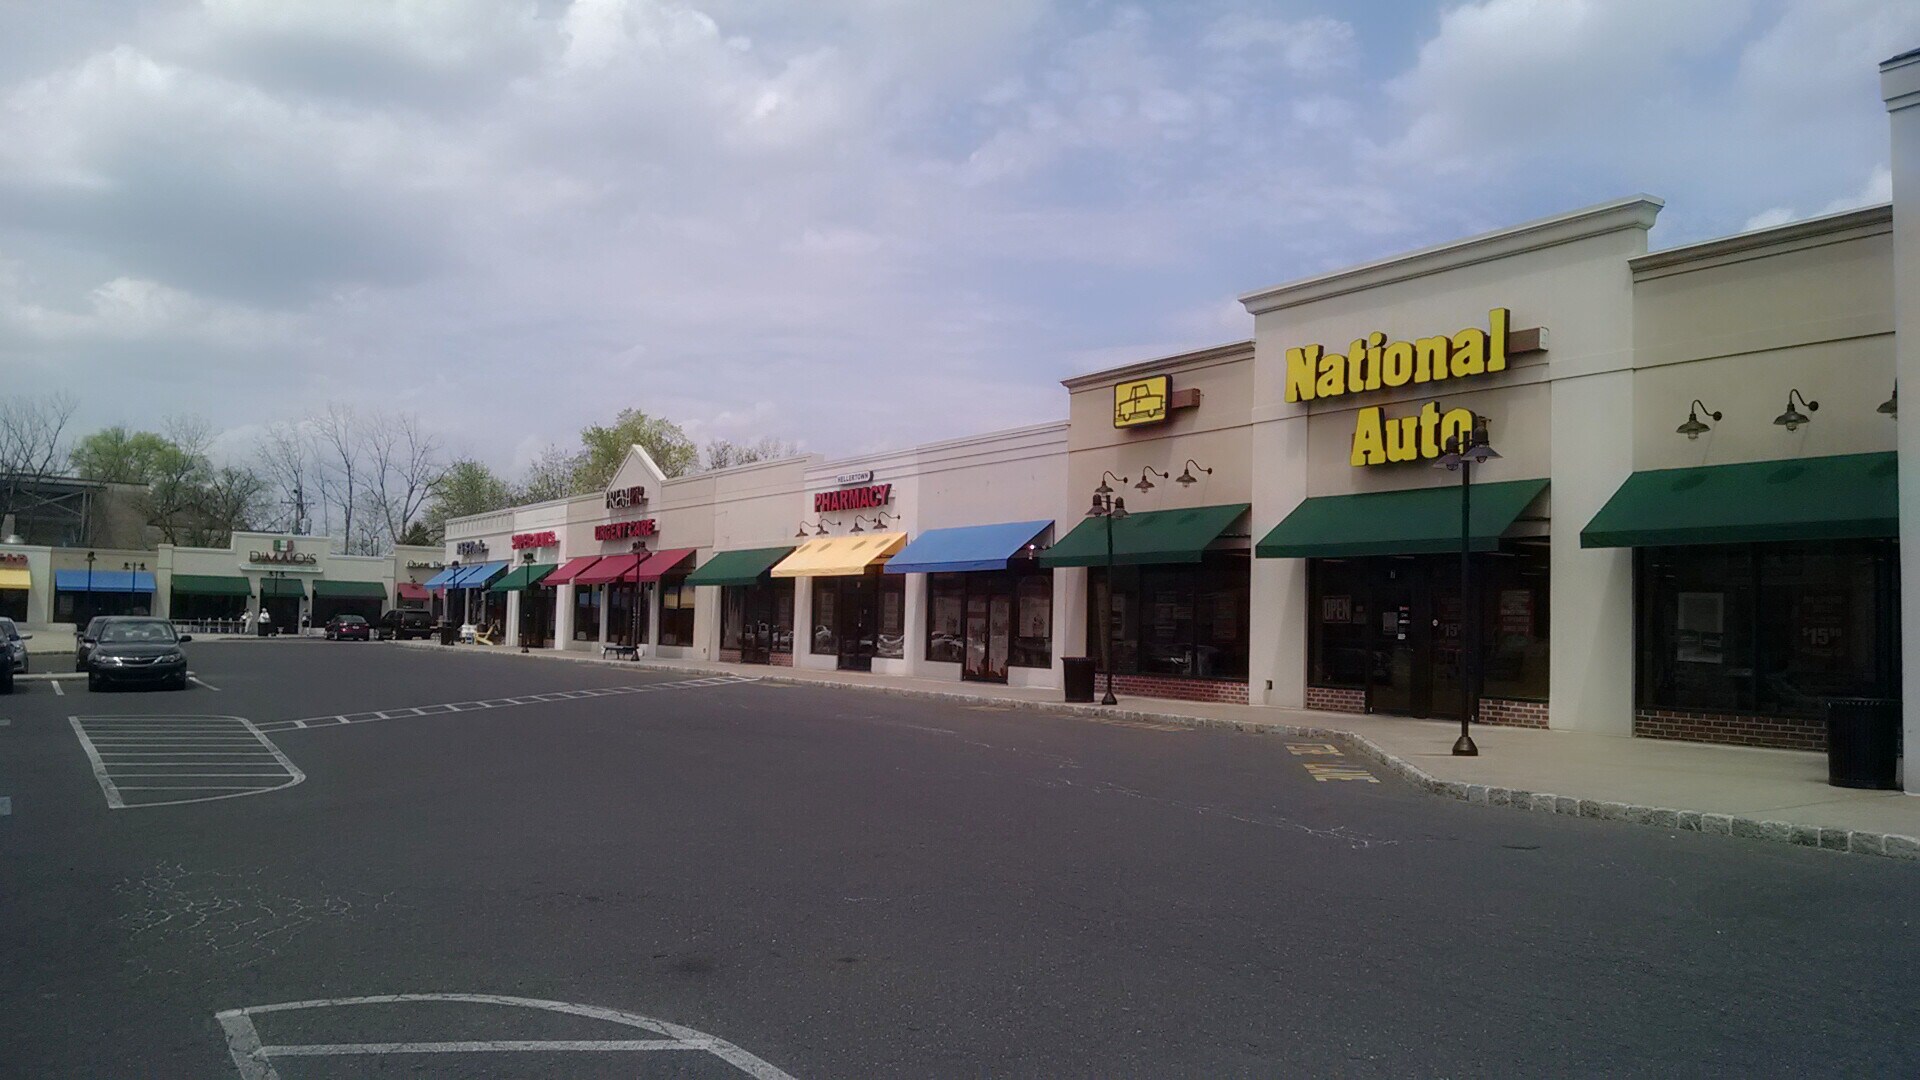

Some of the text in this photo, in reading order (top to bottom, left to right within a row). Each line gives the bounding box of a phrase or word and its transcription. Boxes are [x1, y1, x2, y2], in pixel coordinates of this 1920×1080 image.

[1285, 308, 1510, 403] National
[1351, 401, 1478, 467] Auto
[837, 472, 869, 483] HELLERTOWN
[814, 484, 892, 513] PHARMACY
[595, 518, 656, 541] URGENT CARE
[1324, 598, 1350, 620] OPEN
